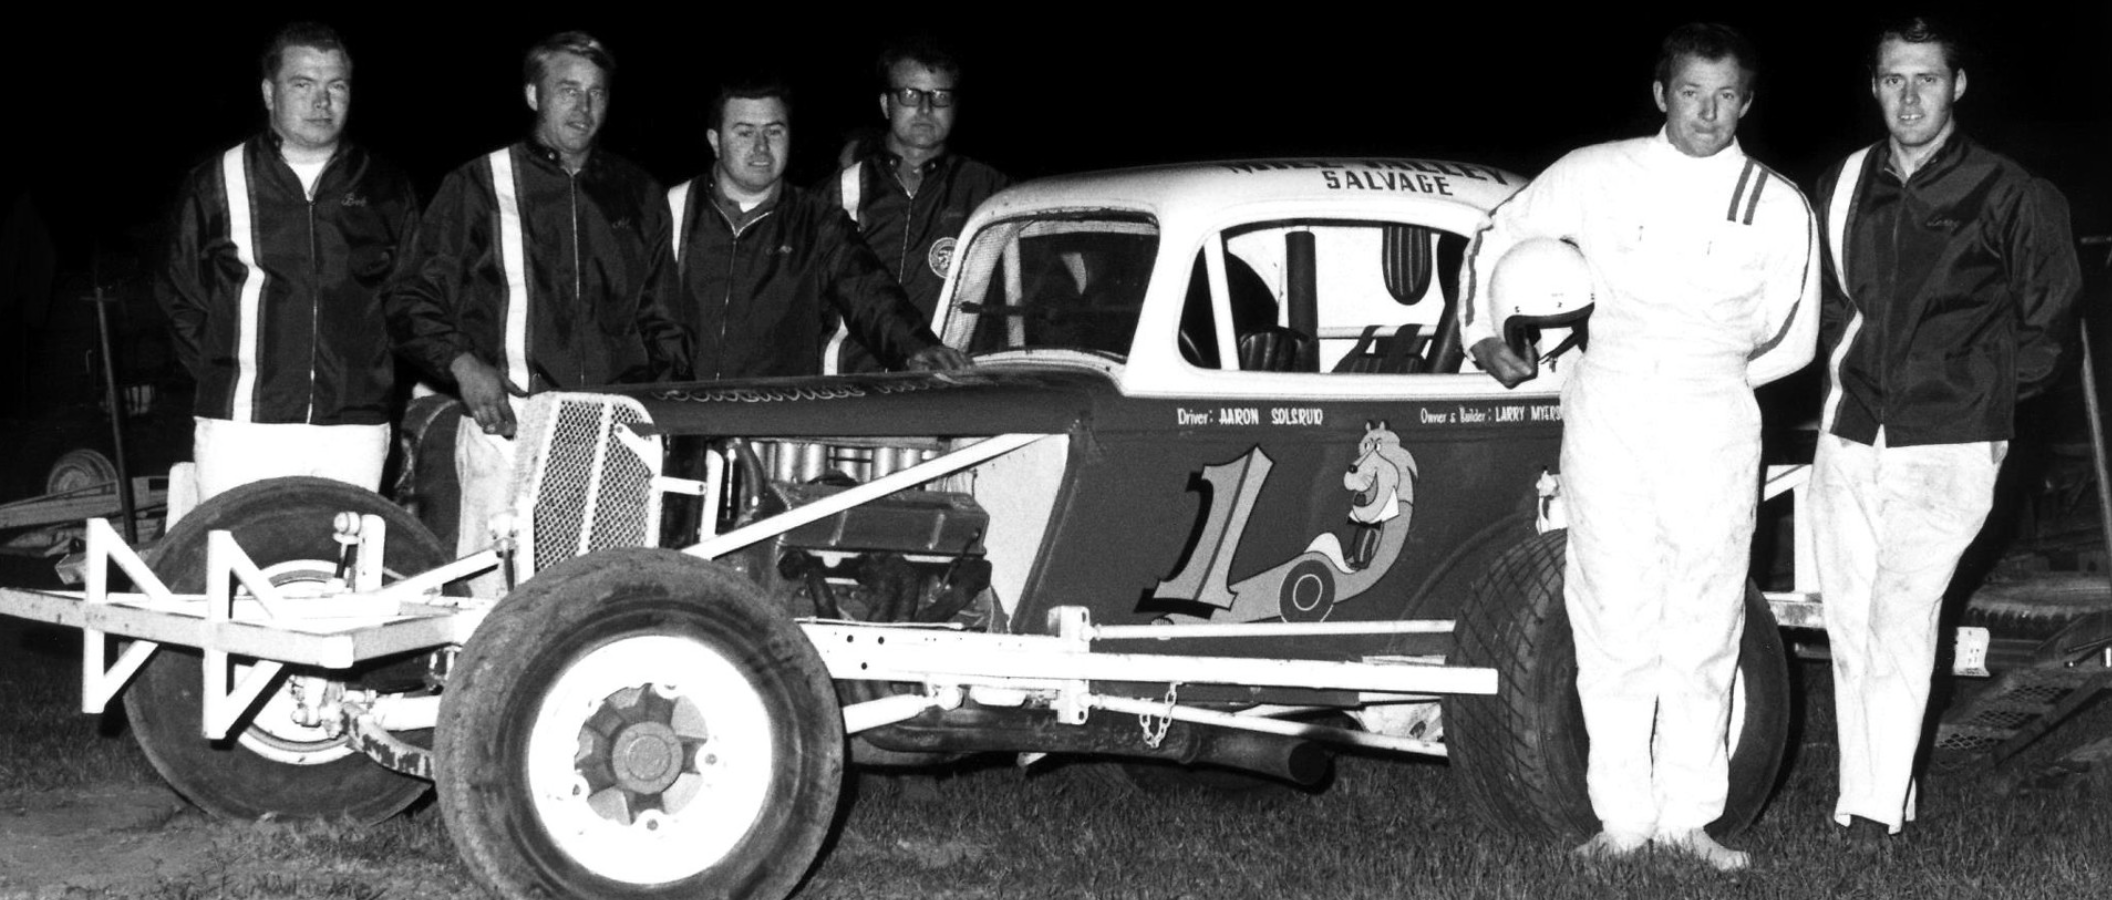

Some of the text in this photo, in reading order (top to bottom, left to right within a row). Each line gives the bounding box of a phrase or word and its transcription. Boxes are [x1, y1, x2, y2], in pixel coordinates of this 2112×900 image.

[1322, 171, 1454, 195] SALVAGE
[1176, 407, 1214, 426] Driver:
[1218, 407, 1260, 426] AARON
[1420, 407, 1447, 424] Owner
[1495, 405, 1525, 422] LARRY
[1530, 405, 1561, 422] MYERS
[1148, 443, 1276, 613] 1
